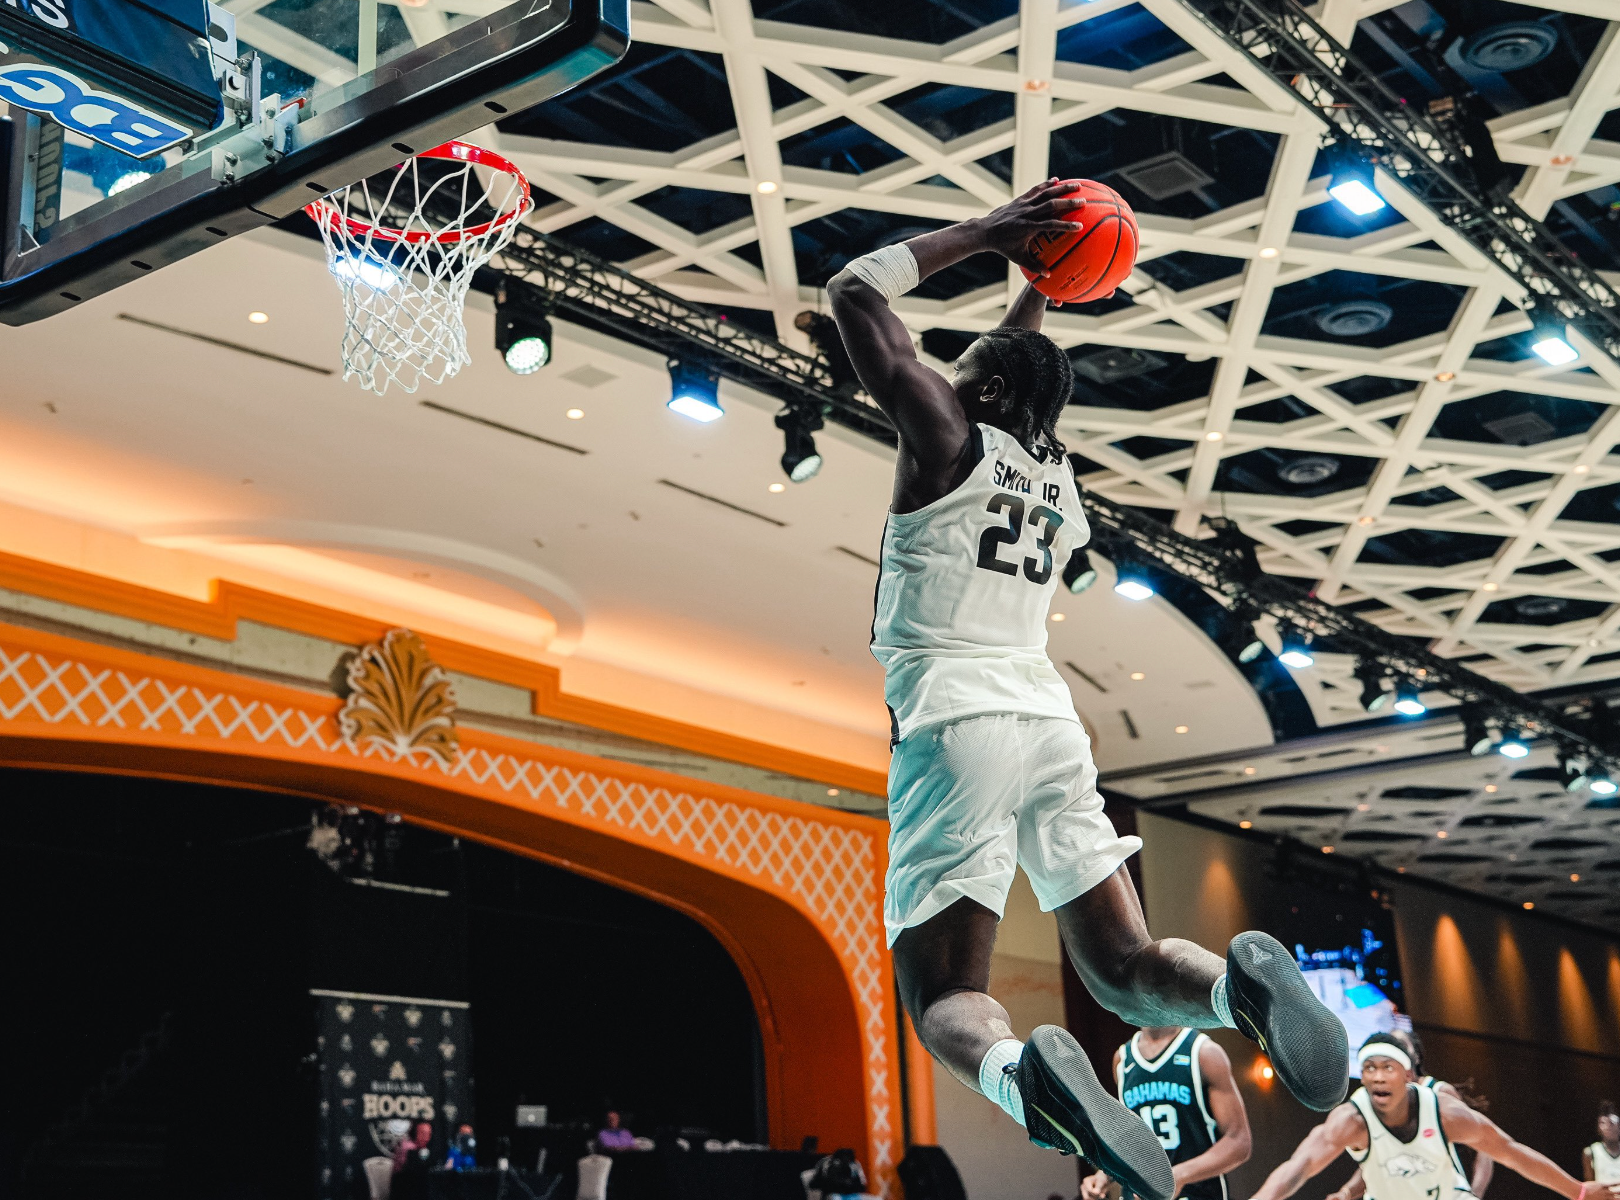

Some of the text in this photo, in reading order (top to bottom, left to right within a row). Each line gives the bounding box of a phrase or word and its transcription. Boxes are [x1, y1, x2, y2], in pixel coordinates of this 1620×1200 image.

[977, 492, 1065, 585] 23
[362, 1093, 435, 1120] HOOPS
[1123, 1081, 1191, 1109] BAHAMAS
[1139, 1104, 1181, 1150] 13
